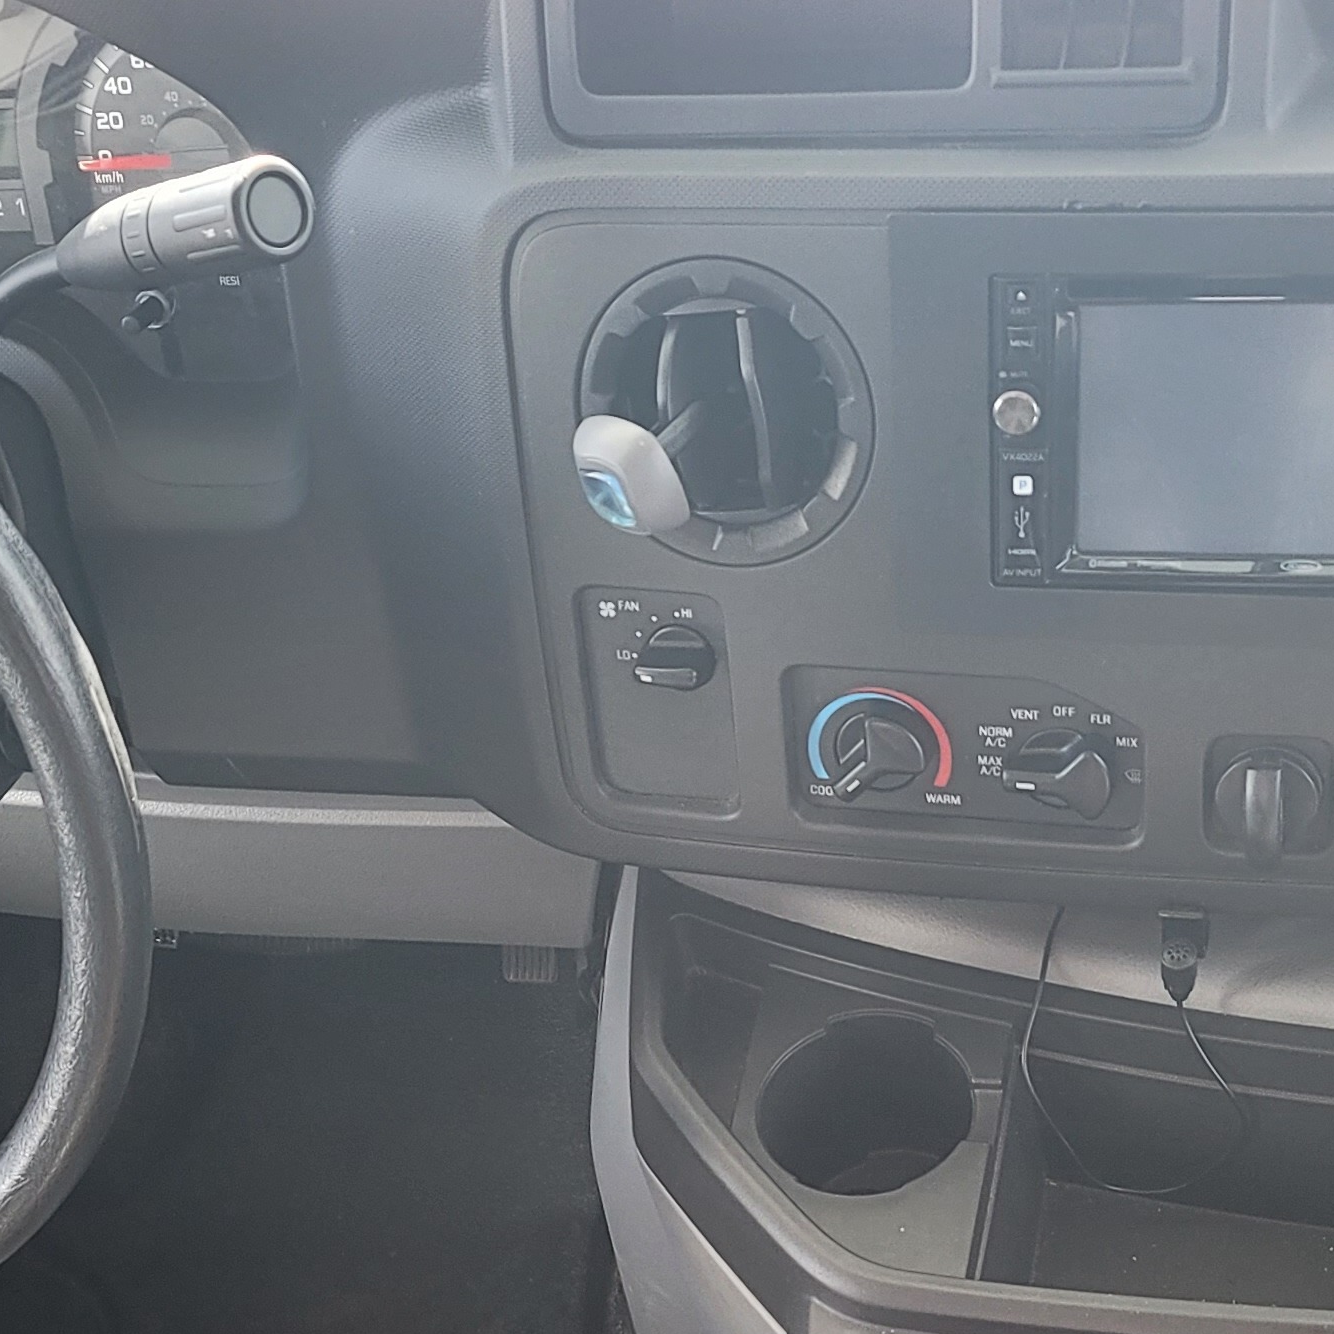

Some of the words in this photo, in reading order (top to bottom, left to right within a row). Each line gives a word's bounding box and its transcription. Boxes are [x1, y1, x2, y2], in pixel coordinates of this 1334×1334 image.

[130, 54, 155, 69] 6
[104, 77, 132, 95] 40
[95, 112, 124, 130] 20
[94, 171, 125, 184] km/h
[617, 600, 640, 612] FAN
[681, 608, 693, 619] HI
[616, 649, 631, 660] LO
[1010, 708, 1040, 721] VENT
[1053, 705, 1076, 717] OFF
[1090, 713, 1112, 725] FLR
[978, 725, 1013, 738] NORM
[985, 737, 1007, 748] A/C
[1116, 736, 1138, 748] MIX
[977, 755, 1003, 767] MAX
[980, 766, 1002, 777] A/C
[810, 784, 834, 796] COO
[925, 793, 962, 806] WARM
